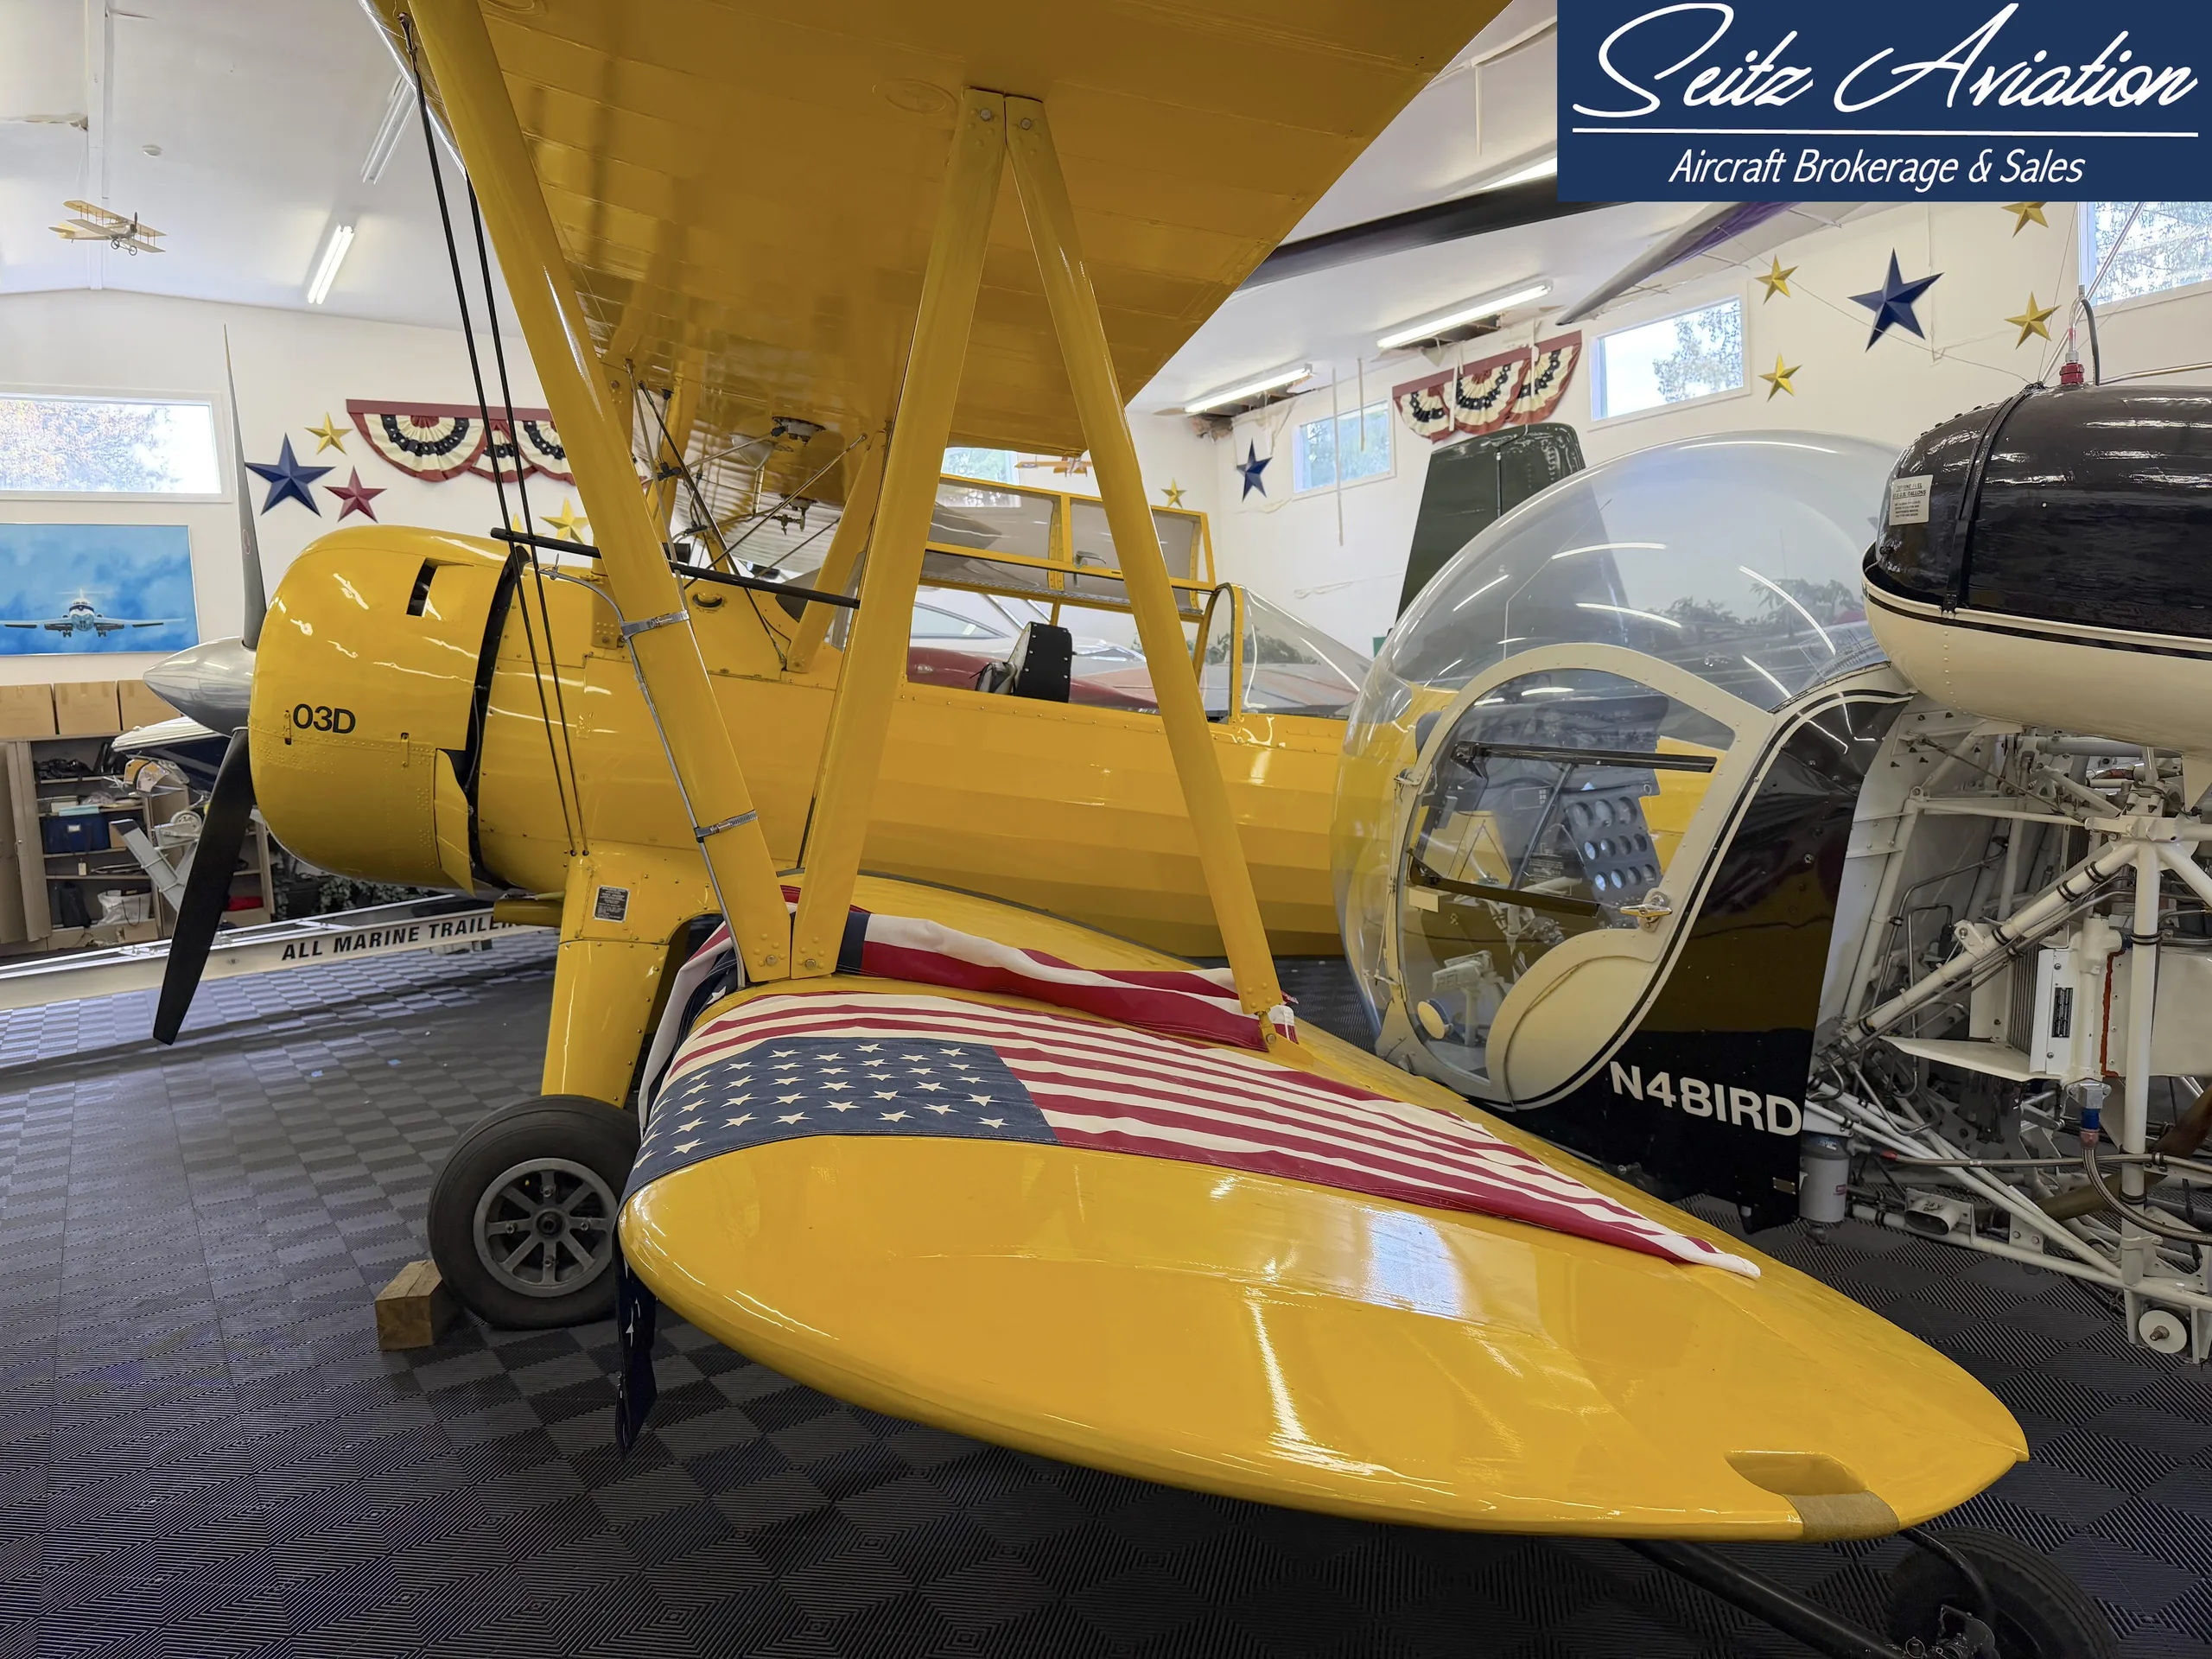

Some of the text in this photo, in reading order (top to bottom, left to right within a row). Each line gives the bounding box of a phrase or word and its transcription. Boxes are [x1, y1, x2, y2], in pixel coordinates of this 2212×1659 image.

[293, 703, 356, 734] 03D
[281, 940, 323, 961] ALL
[333, 925, 420, 954] MARINE
